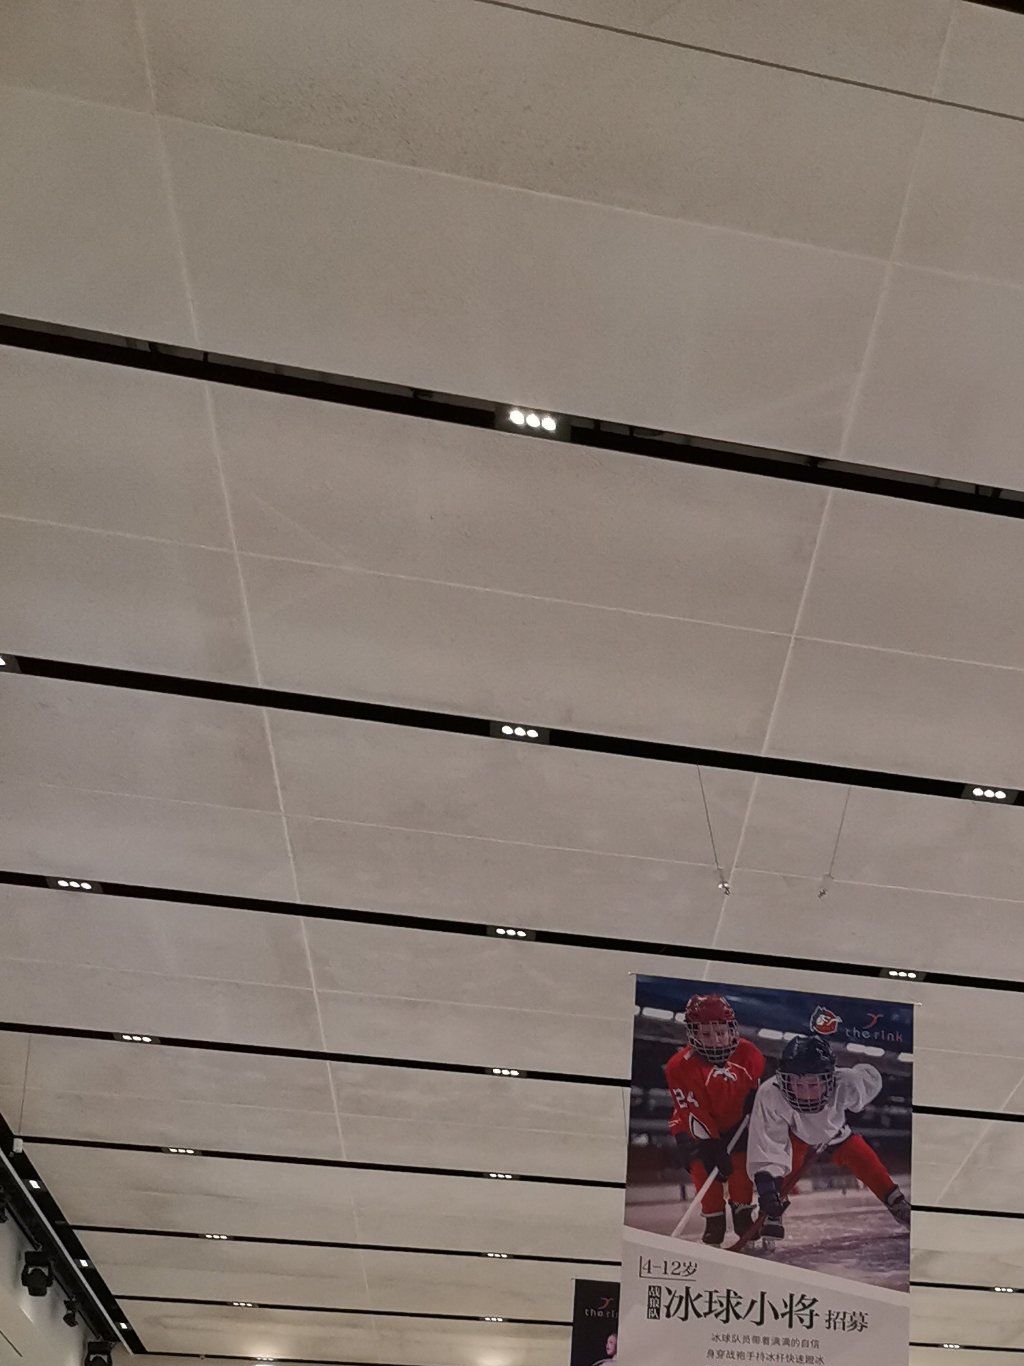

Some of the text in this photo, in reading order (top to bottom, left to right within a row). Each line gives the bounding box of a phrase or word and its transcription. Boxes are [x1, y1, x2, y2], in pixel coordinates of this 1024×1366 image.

[673, 1088, 699, 1108] 24
[642, 1257, 698, 1277] 4-12岁
[663, 1286, 868, 1332] 冰球小将 招募
